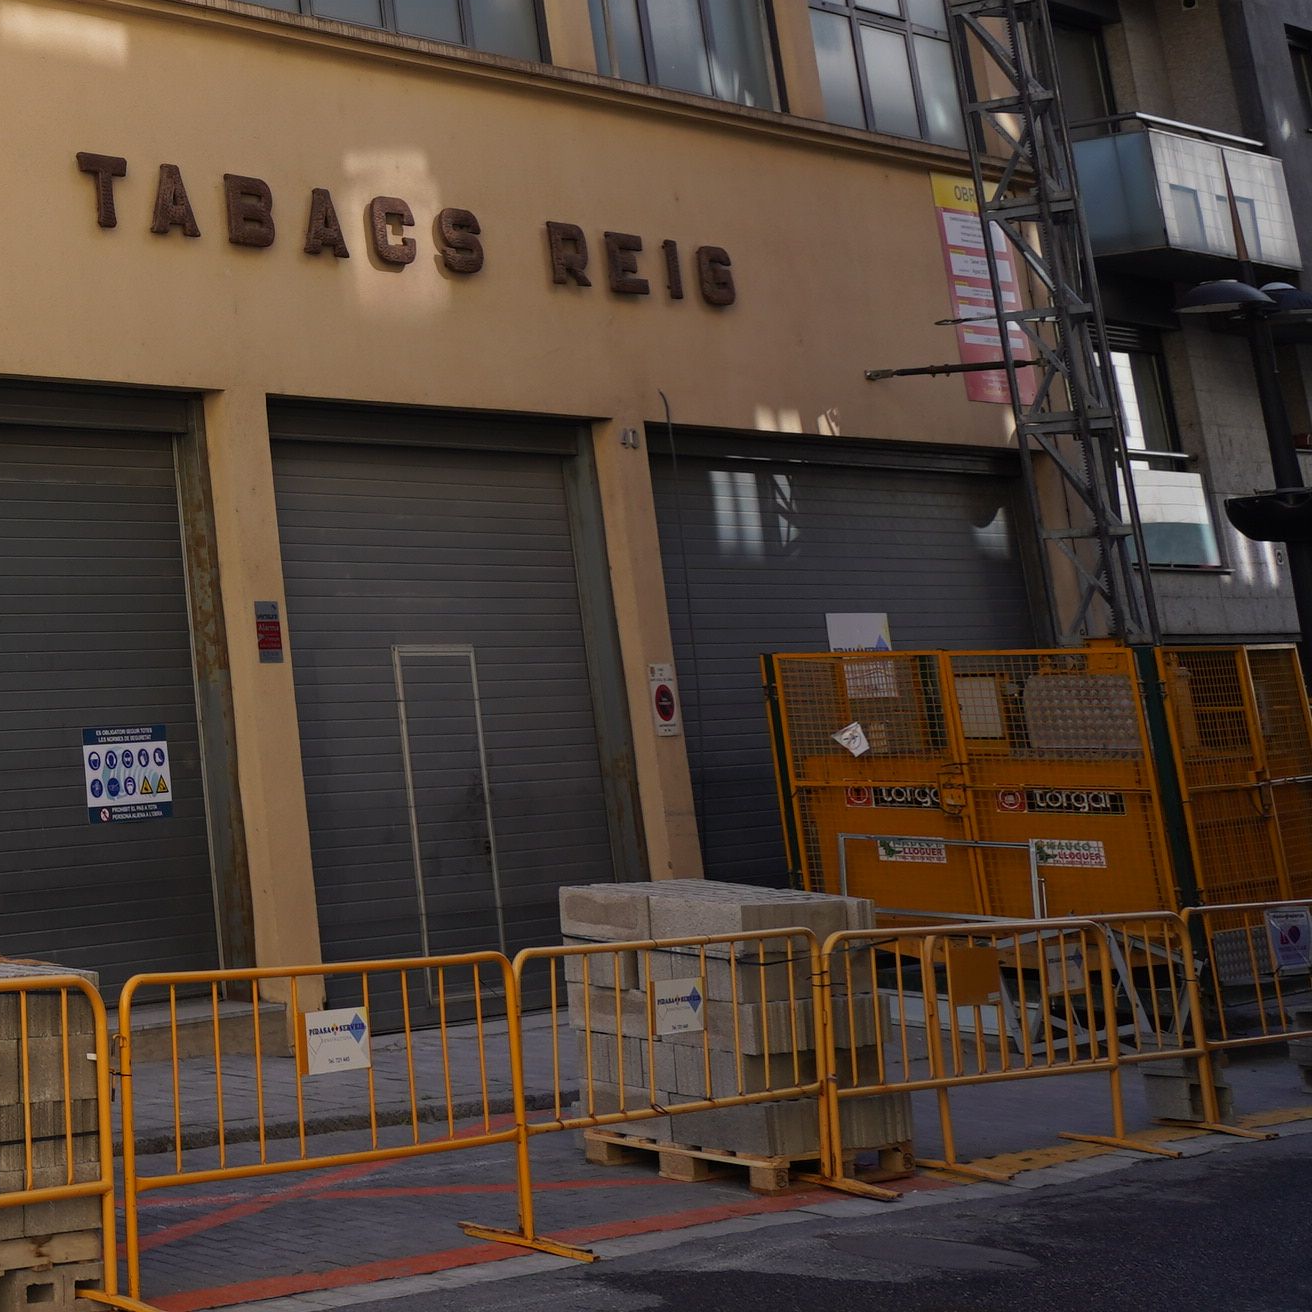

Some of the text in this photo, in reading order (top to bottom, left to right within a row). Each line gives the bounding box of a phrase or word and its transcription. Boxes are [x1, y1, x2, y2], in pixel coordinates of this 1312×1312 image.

[953, 185, 976, 202] OBR
[76, 151, 736, 307] TABACS REIG
[619, 428, 640, 449] 40
[903, 848, 943, 856] LLOGUER
[1058, 851, 1102, 861] LLOGUER
[309, 1027, 332, 1036] PIDASA
